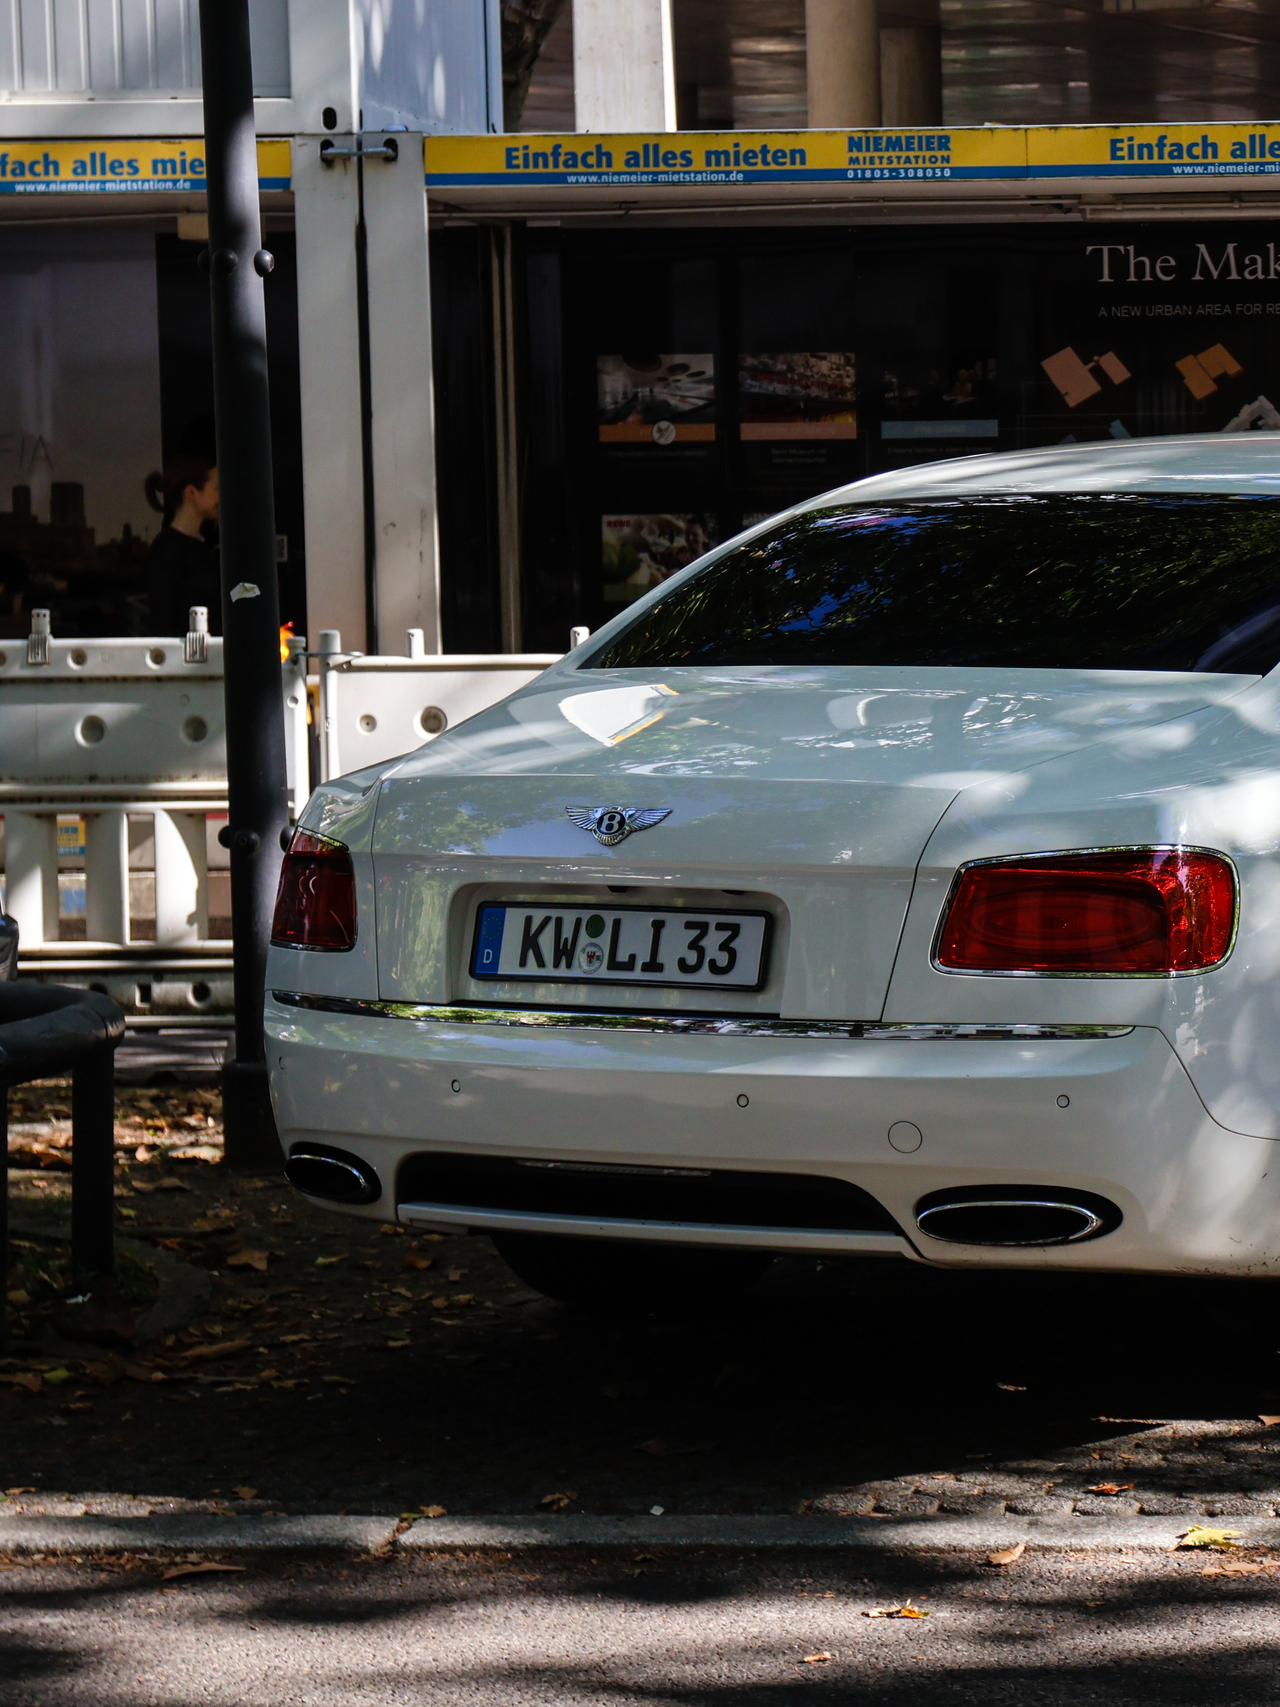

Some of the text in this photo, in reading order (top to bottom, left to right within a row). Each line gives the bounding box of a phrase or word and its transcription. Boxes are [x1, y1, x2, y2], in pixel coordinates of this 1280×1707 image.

[847, 135, 951, 153] NIEMEIER
[1109, 134, 1218, 161] Einfach
[71, 151, 140, 176] alles
[505, 142, 806, 170] Einfach alles mieten
[848, 154, 951, 166] MIETSTATION
[566, 170, 744, 184] www.niemeier-mietstation.de
[847, 168, 951, 179] 01805-308050
[15, 180, 191, 193] www.niemeier-mietstation.de
[1086, 245, 1177, 282] The
[1098, 306, 1108, 317] A
[1111, 305, 1141, 317] NEW
[1146, 304, 1192, 316] URBAN
[1196, 303, 1232, 315] AREA
[1236, 303, 1262, 315] FOR
[518, 914, 582, 969] KW
[483, 948, 493, 964] D
